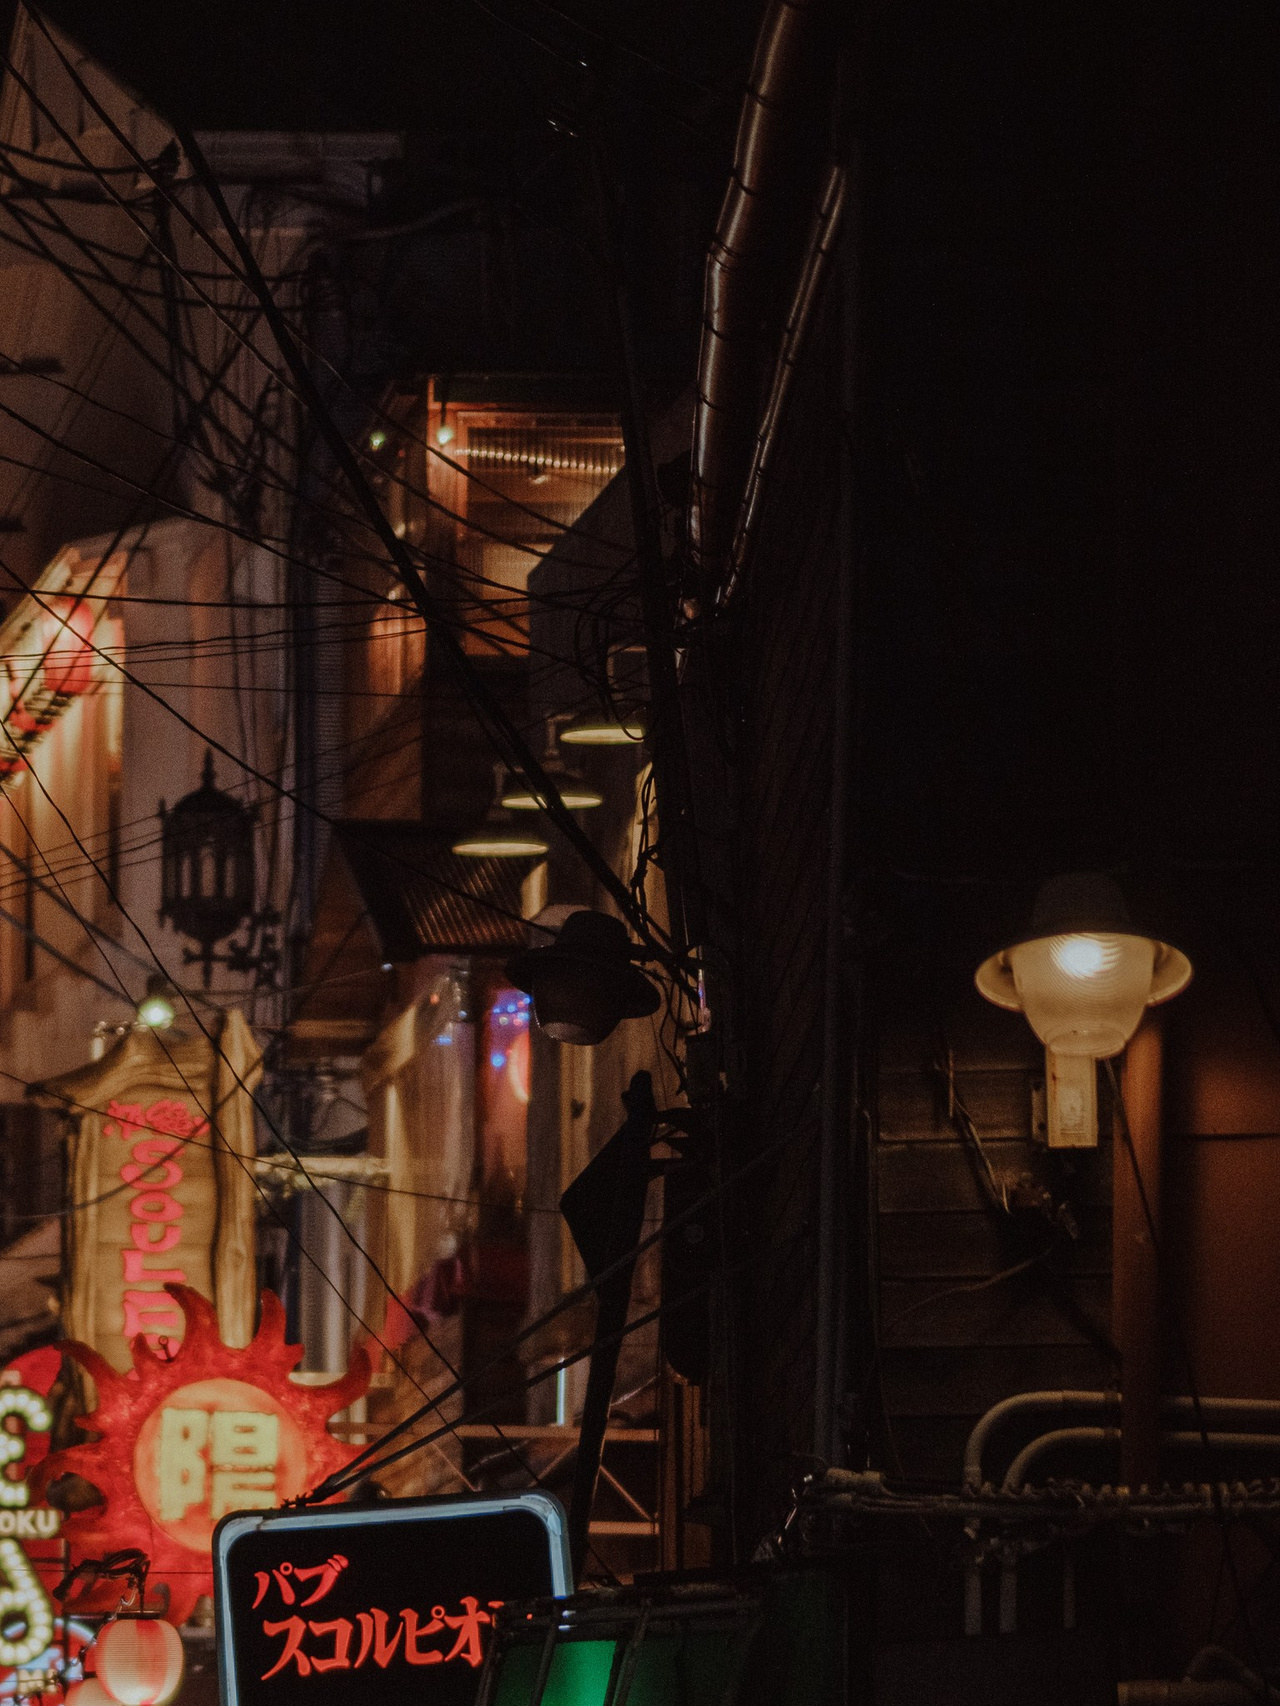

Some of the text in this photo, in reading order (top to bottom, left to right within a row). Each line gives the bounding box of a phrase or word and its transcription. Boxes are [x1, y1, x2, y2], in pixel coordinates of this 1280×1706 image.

[251, 1554, 350, 1610] パブ
[261, 1596, 503, 1681] スコルピオ
